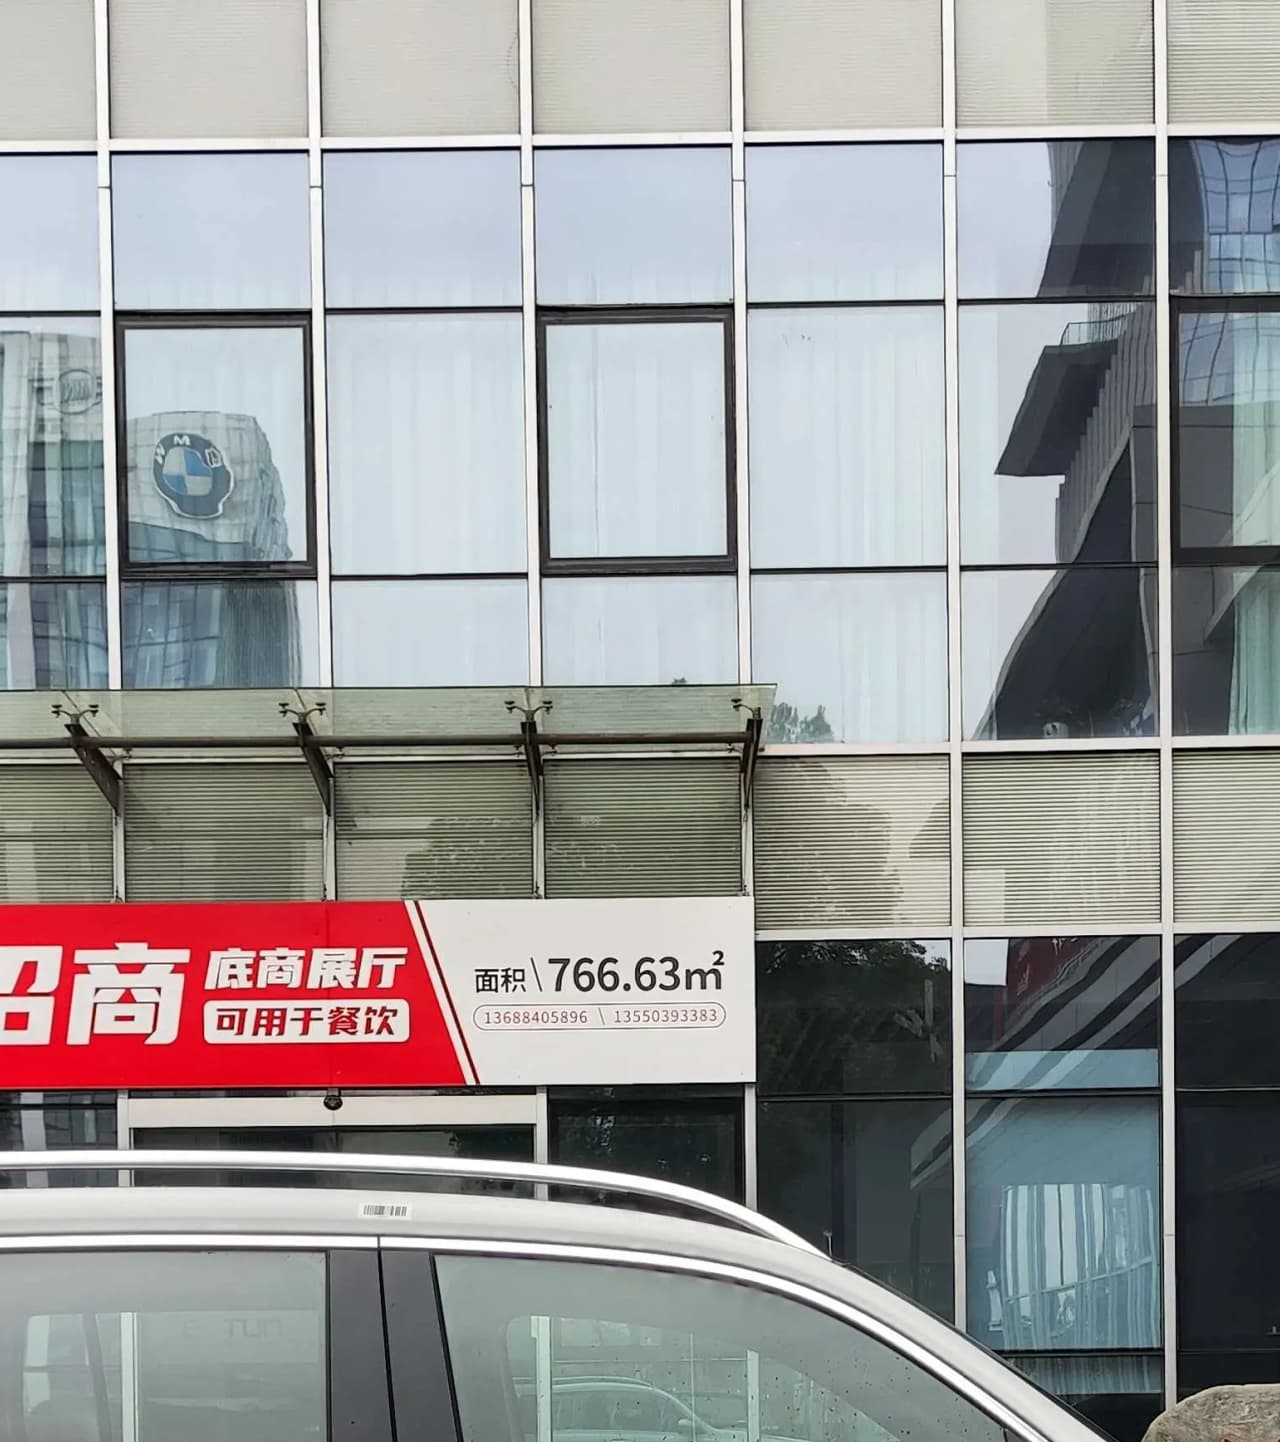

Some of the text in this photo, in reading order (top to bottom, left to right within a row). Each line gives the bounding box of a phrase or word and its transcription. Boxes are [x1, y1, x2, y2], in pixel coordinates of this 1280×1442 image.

[204, 947, 409, 990] 底商展厅
[474, 967, 526, 993] 面积
[216, 1006, 399, 1037] 可用于餐饮
[484, 1008, 718, 1025] 13688405896 13550393383
